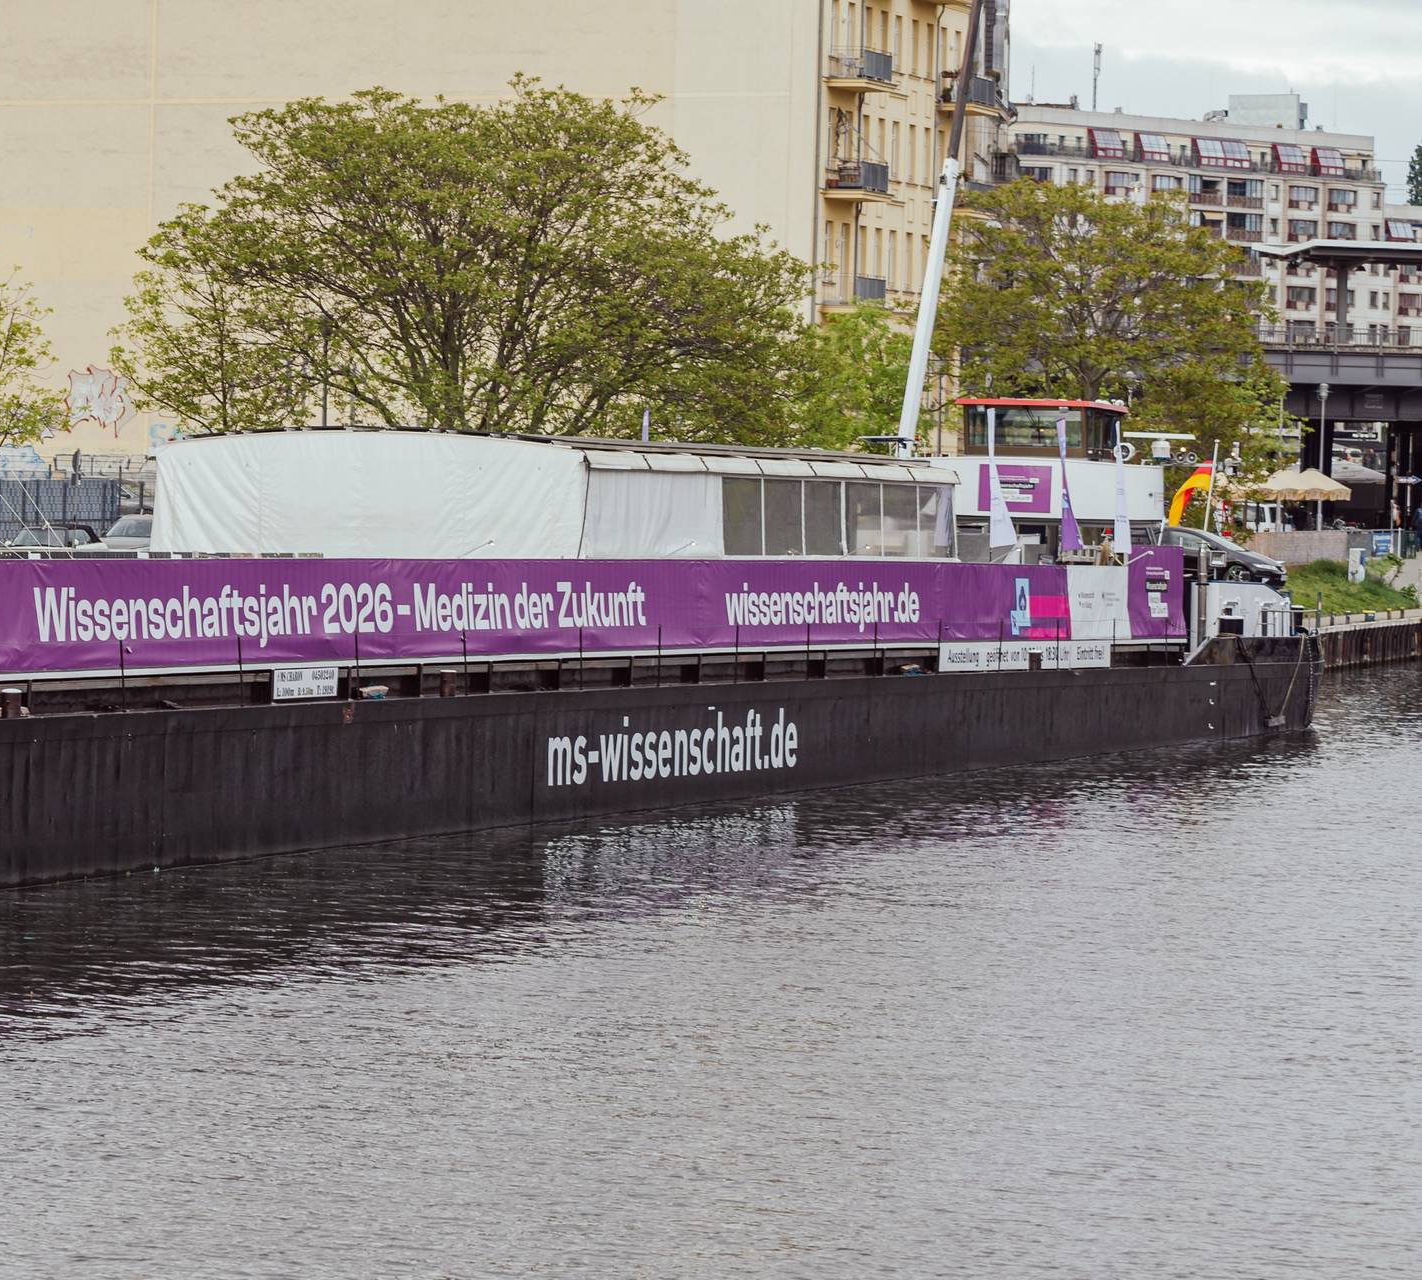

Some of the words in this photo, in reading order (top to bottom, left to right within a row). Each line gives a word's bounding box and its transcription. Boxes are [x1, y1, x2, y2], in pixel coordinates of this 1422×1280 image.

[33, 584, 318, 648] Wissenschaftsjahr
[321, 582, 394, 634] 2026
[413, 582, 513, 632] Medizin
[514, 582, 555, 630] der
[556, 581, 647, 628] Zukunft
[725, 581, 920, 633] wissenschaftsjahr.de
[947, 649, 980, 667] Ausstellung
[1010, 650, 1020, 662] von
[547, 707, 799, 787] ms-wissenschaft.de
